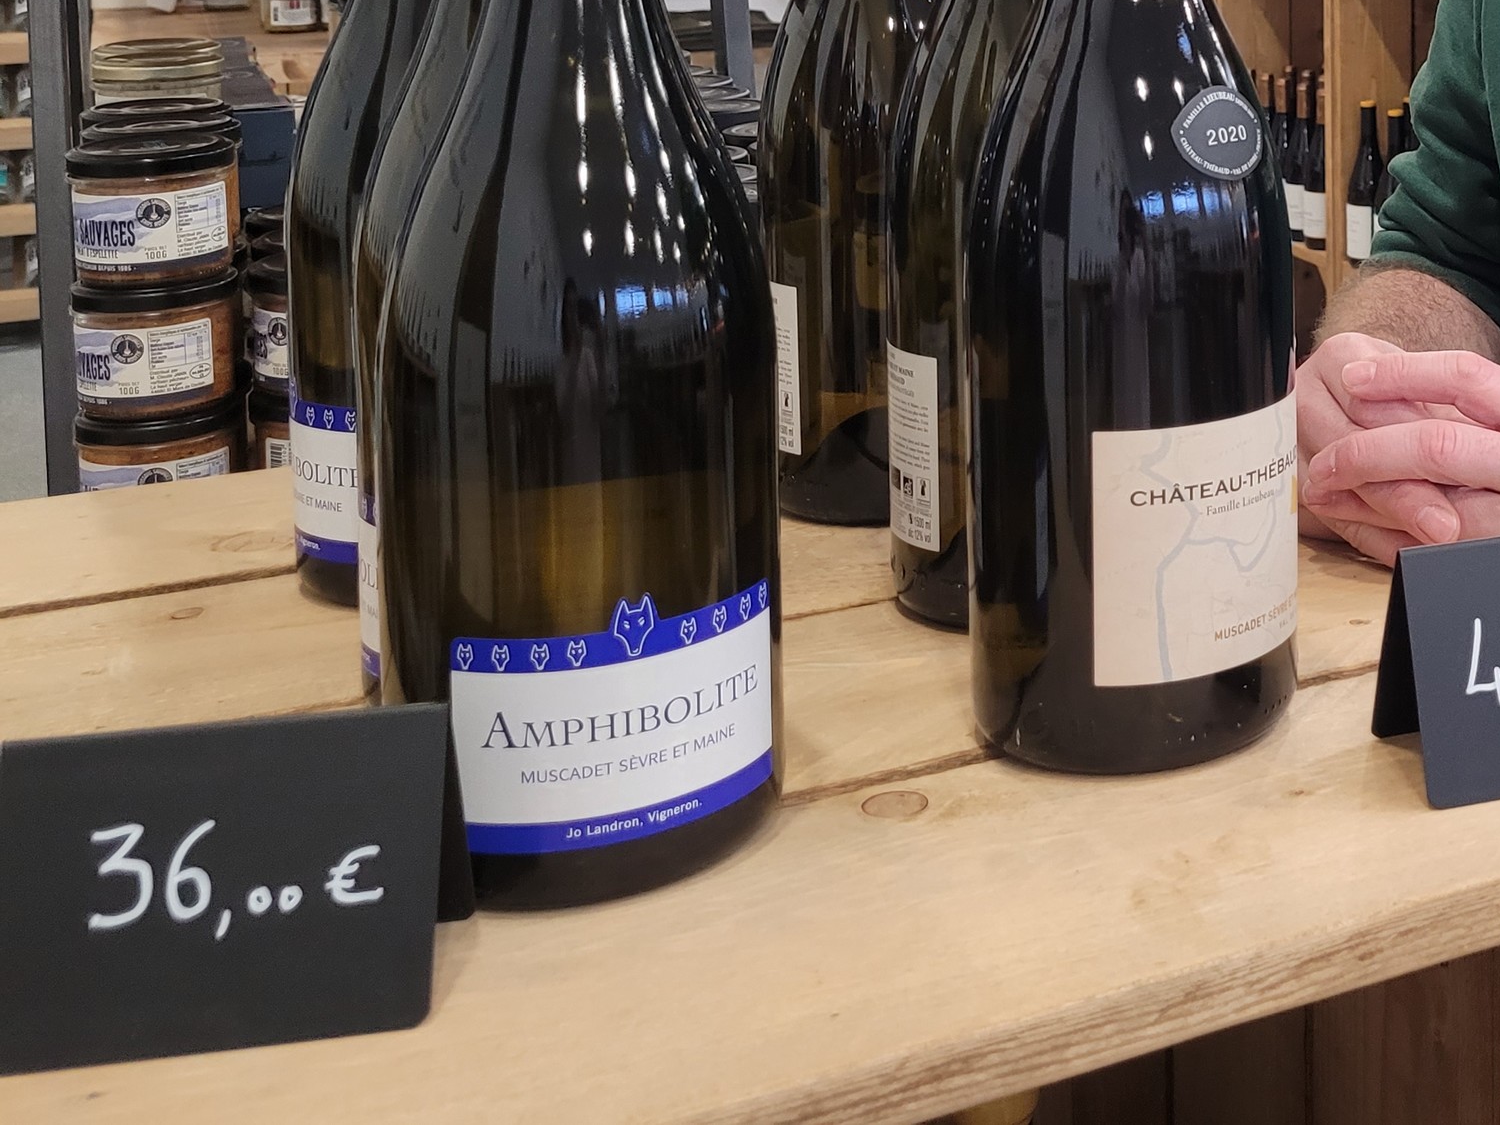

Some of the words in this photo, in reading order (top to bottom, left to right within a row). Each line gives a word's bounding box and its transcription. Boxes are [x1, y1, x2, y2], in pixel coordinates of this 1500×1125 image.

[1183, 101, 1205, 129] FAMILLE
[1206, 124, 1247, 147] 2020
[79, 220, 136, 248] SAUVAGES
[144, 250, 168, 260] 100G
[118, 387, 140, 395] 100G
[314, 498, 343, 513] MAINE
[1205, 499, 1241, 517] Famille
[1242, 488, 1275, 508] Lieubeau
[1214, 613, 1267, 642] MUSCADET
[1267, 599, 1289, 623] SÈVRE
[481, 664, 759, 749] AMPHIBOLITE
[520, 762, 614, 784] MUSCADET
[618, 747, 668, 773] SÈVRE
[673, 741, 690, 759] ET
[692, 723, 736, 752] MAINE
[565, 827, 582, 839] Jo
[586, 815, 644, 836] Landron,
[647, 797, 703, 823] Vigneron.
[88, 818, 303, 941] 36,00
[325, 844, 384, 906] €
